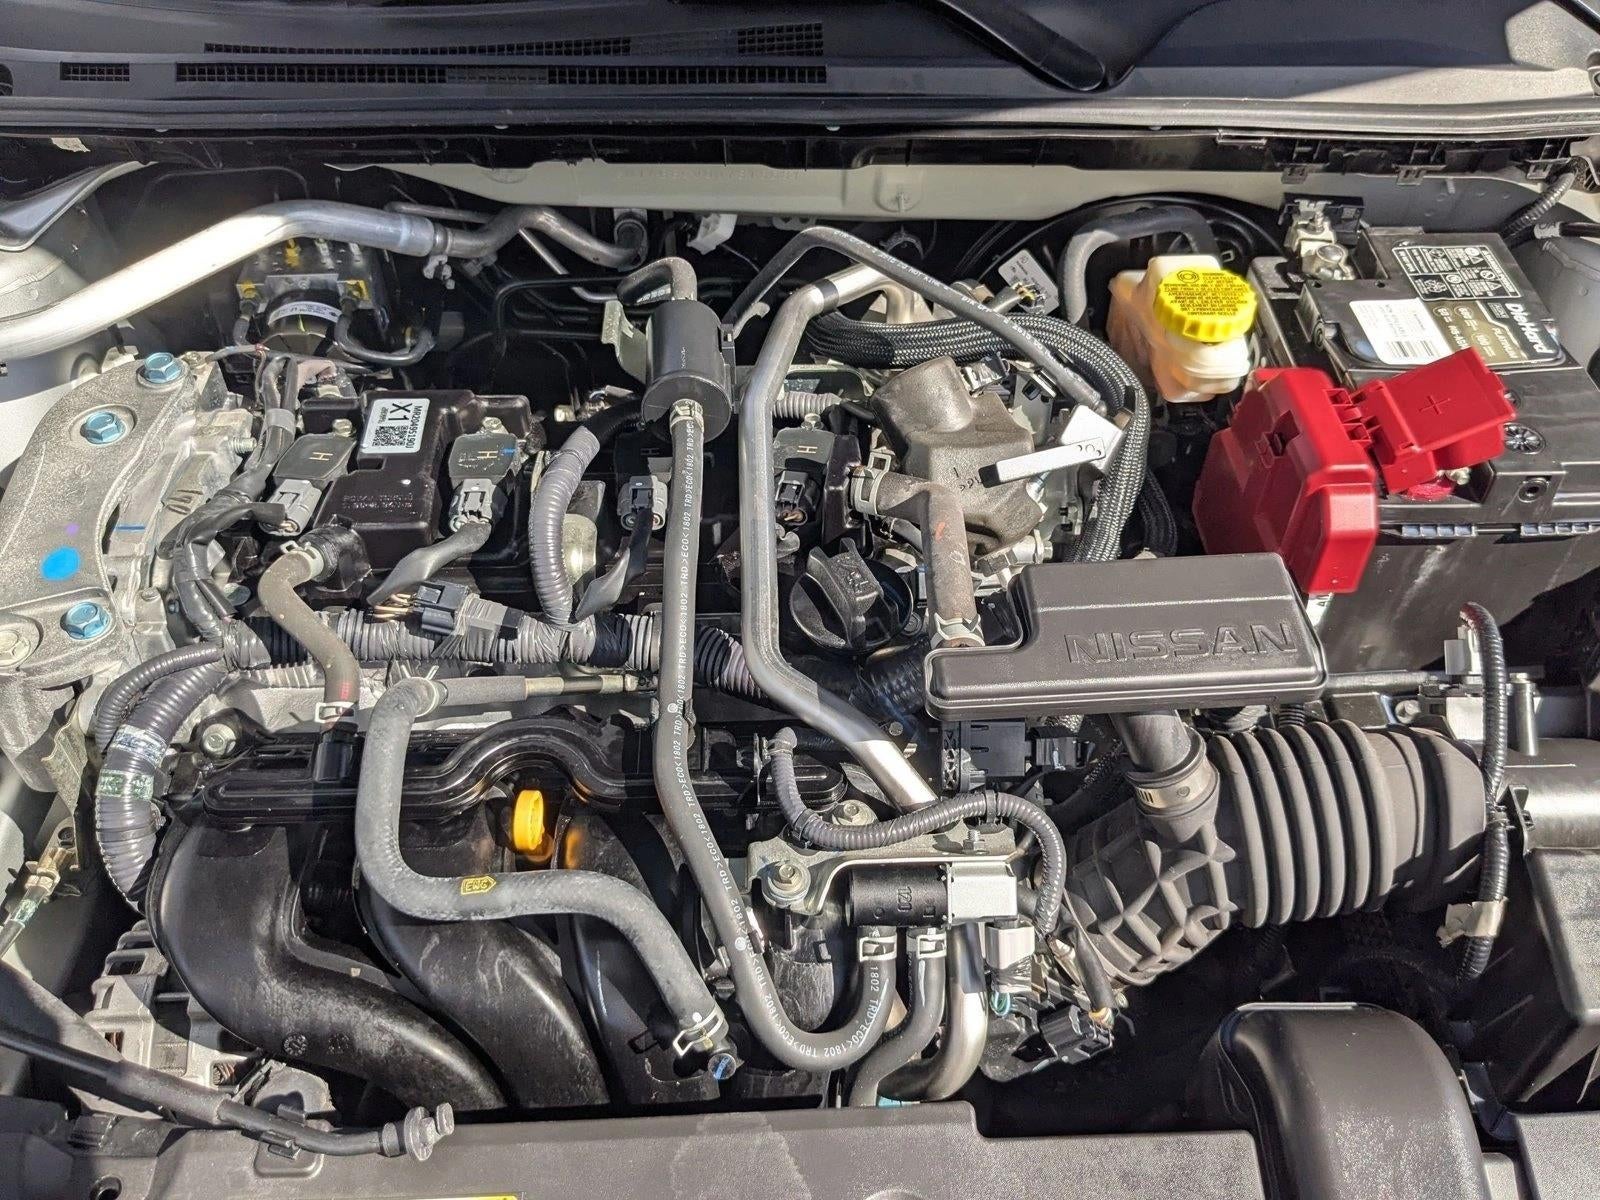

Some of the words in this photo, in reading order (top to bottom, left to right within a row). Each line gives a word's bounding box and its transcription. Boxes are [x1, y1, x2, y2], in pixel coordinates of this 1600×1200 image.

[1505, 303, 1555, 353] DieHard
[388, 403, 413, 421] X1
[1063, 623, 1298, 664] NISSAN
[870, 966, 880, 992] 1802
